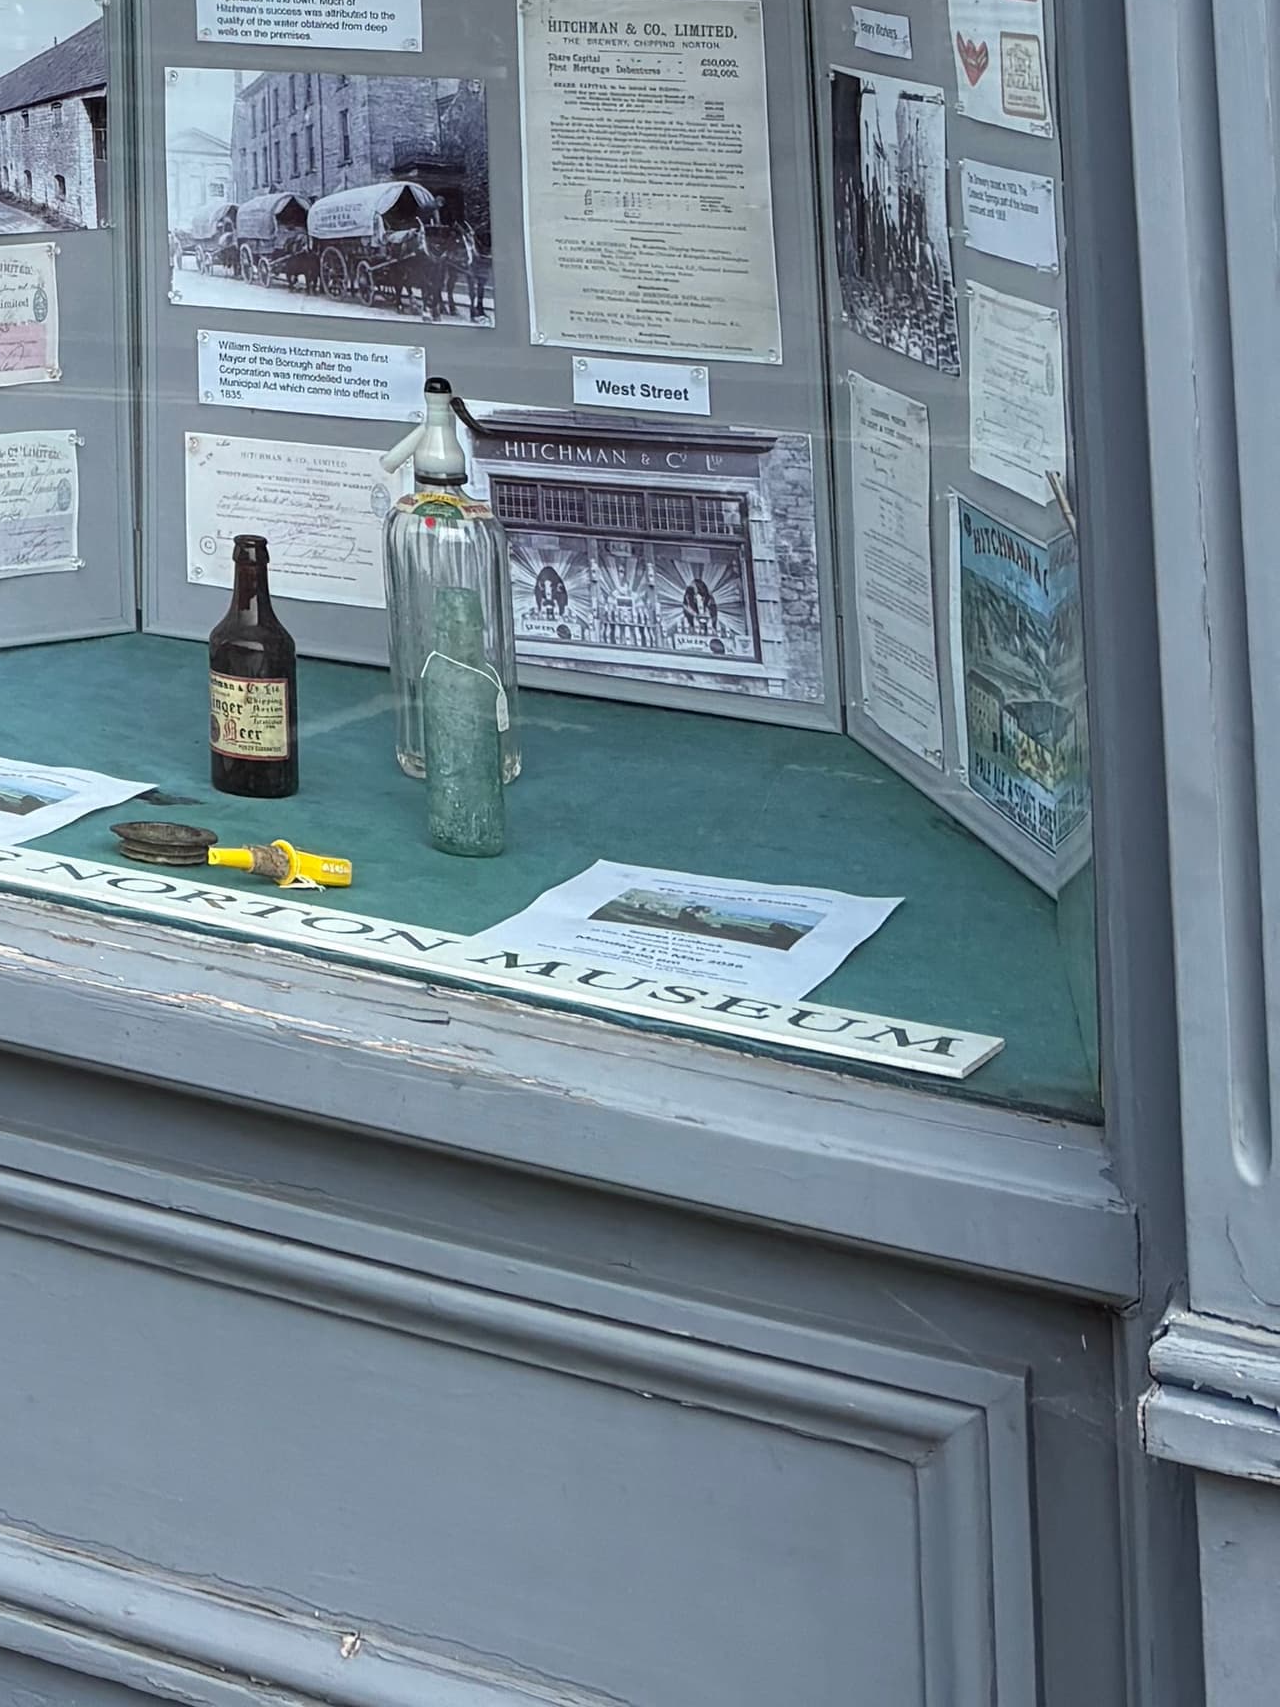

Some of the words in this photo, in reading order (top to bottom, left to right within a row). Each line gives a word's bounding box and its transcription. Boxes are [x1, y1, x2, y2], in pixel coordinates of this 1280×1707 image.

[216, 3, 264, 14] Hitchman's
[265, 7, 302, 15] success
[324, 9, 367, 18] attributed
[369, 10, 379, 19] to
[380, 11, 395, 20] the
[216, 16, 244, 28] quality
[245, 16, 255, 25] of
[256, 18, 272, 26] the
[273, 19, 299, 27] water
[300, 19, 339, 29] obtained
[341, 20, 362, 30] from
[364, 22, 388, 33] deep
[217, 27, 239, 36] wells
[253, 29, 268, 37] the
[269, 31, 312, 40] premises.
[547, 20, 618, 33] HITCHMAN
[625, 22, 636, 34] &
[643, 23, 667, 36] CO.,
[674, 24, 737, 38] LIMITED.
[218, 340, 250, 352] William
[288, 346, 331, 358] Hitchman
[332, 351, 352, 360] was
[353, 352, 368, 361] the
[371, 352, 388, 363] first
[218, 352, 246, 366] Mayor
[248, 355, 257, 364] of
[259, 356, 273, 365] the
[275, 356, 313, 370] Borough
[315, 361, 335, 370] after
[337, 363, 352, 372] the
[218, 364, 271, 377] Corporation
[272, 371, 291, 379] was
[292, 372, 342, 383] remodelled
[343, 377, 371, 386] under
[372, 378, 388, 387] the
[219, 377, 261, 391] Municipal
[262, 380, 277, 390] Act
[278, 383, 305, 392] which
[306, 386, 332, 395] came
[333, 387, 351, 397] into
[352, 389, 379, 399] effect
[380, 390, 390, 400] in
[595, 379, 636, 396] West
[640, 383, 689, 400] Street
[504, 441, 627, 465] HITCHMAN
[640, 453, 650, 465] &
[40, 858, 459, 953] NORTON
[467, 950, 959, 1058] MUSEUM
